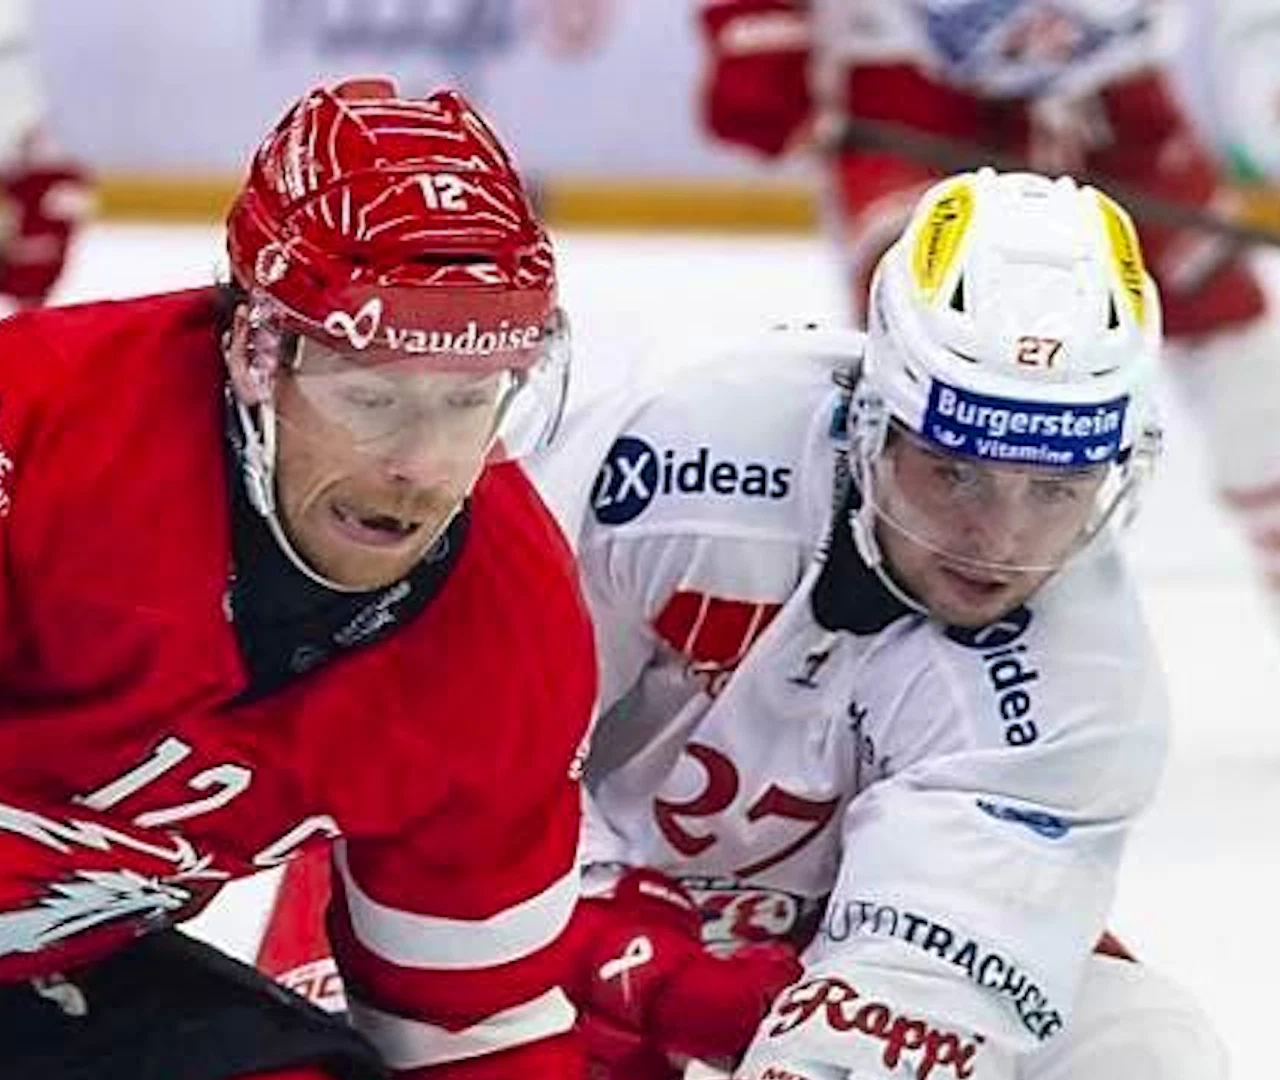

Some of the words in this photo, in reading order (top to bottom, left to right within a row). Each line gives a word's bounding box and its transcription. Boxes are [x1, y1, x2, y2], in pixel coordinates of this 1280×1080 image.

[418, 173, 468, 211] 12
[384, 318, 540, 356] vaudoise
[1017, 335, 1063, 368] 27
[937, 387, 1119, 438] Burgerstein
[974, 437, 1075, 464] Vitamine
[73, 736, 252, 828] 12
[653, 743, 842, 879] 27
